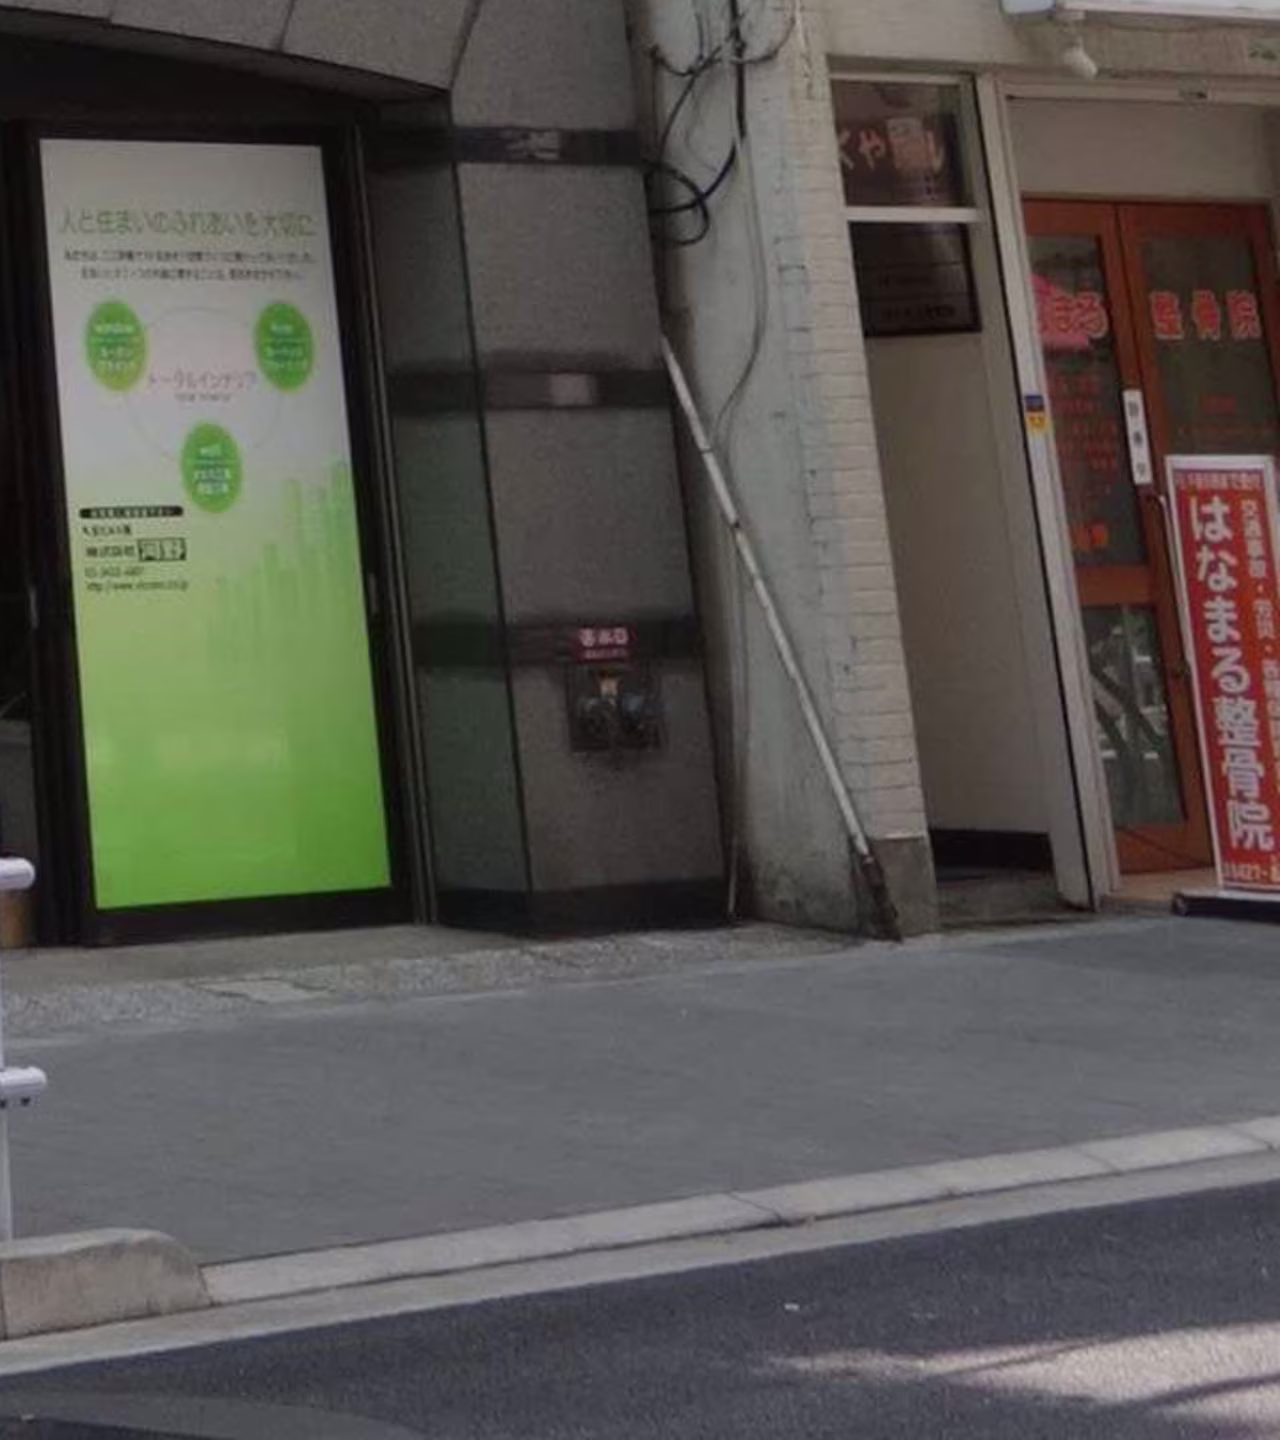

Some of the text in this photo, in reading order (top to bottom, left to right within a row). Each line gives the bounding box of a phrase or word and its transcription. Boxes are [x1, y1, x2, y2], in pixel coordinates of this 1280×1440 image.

[1189, 495, 1275, 854] はなまる整骨院
